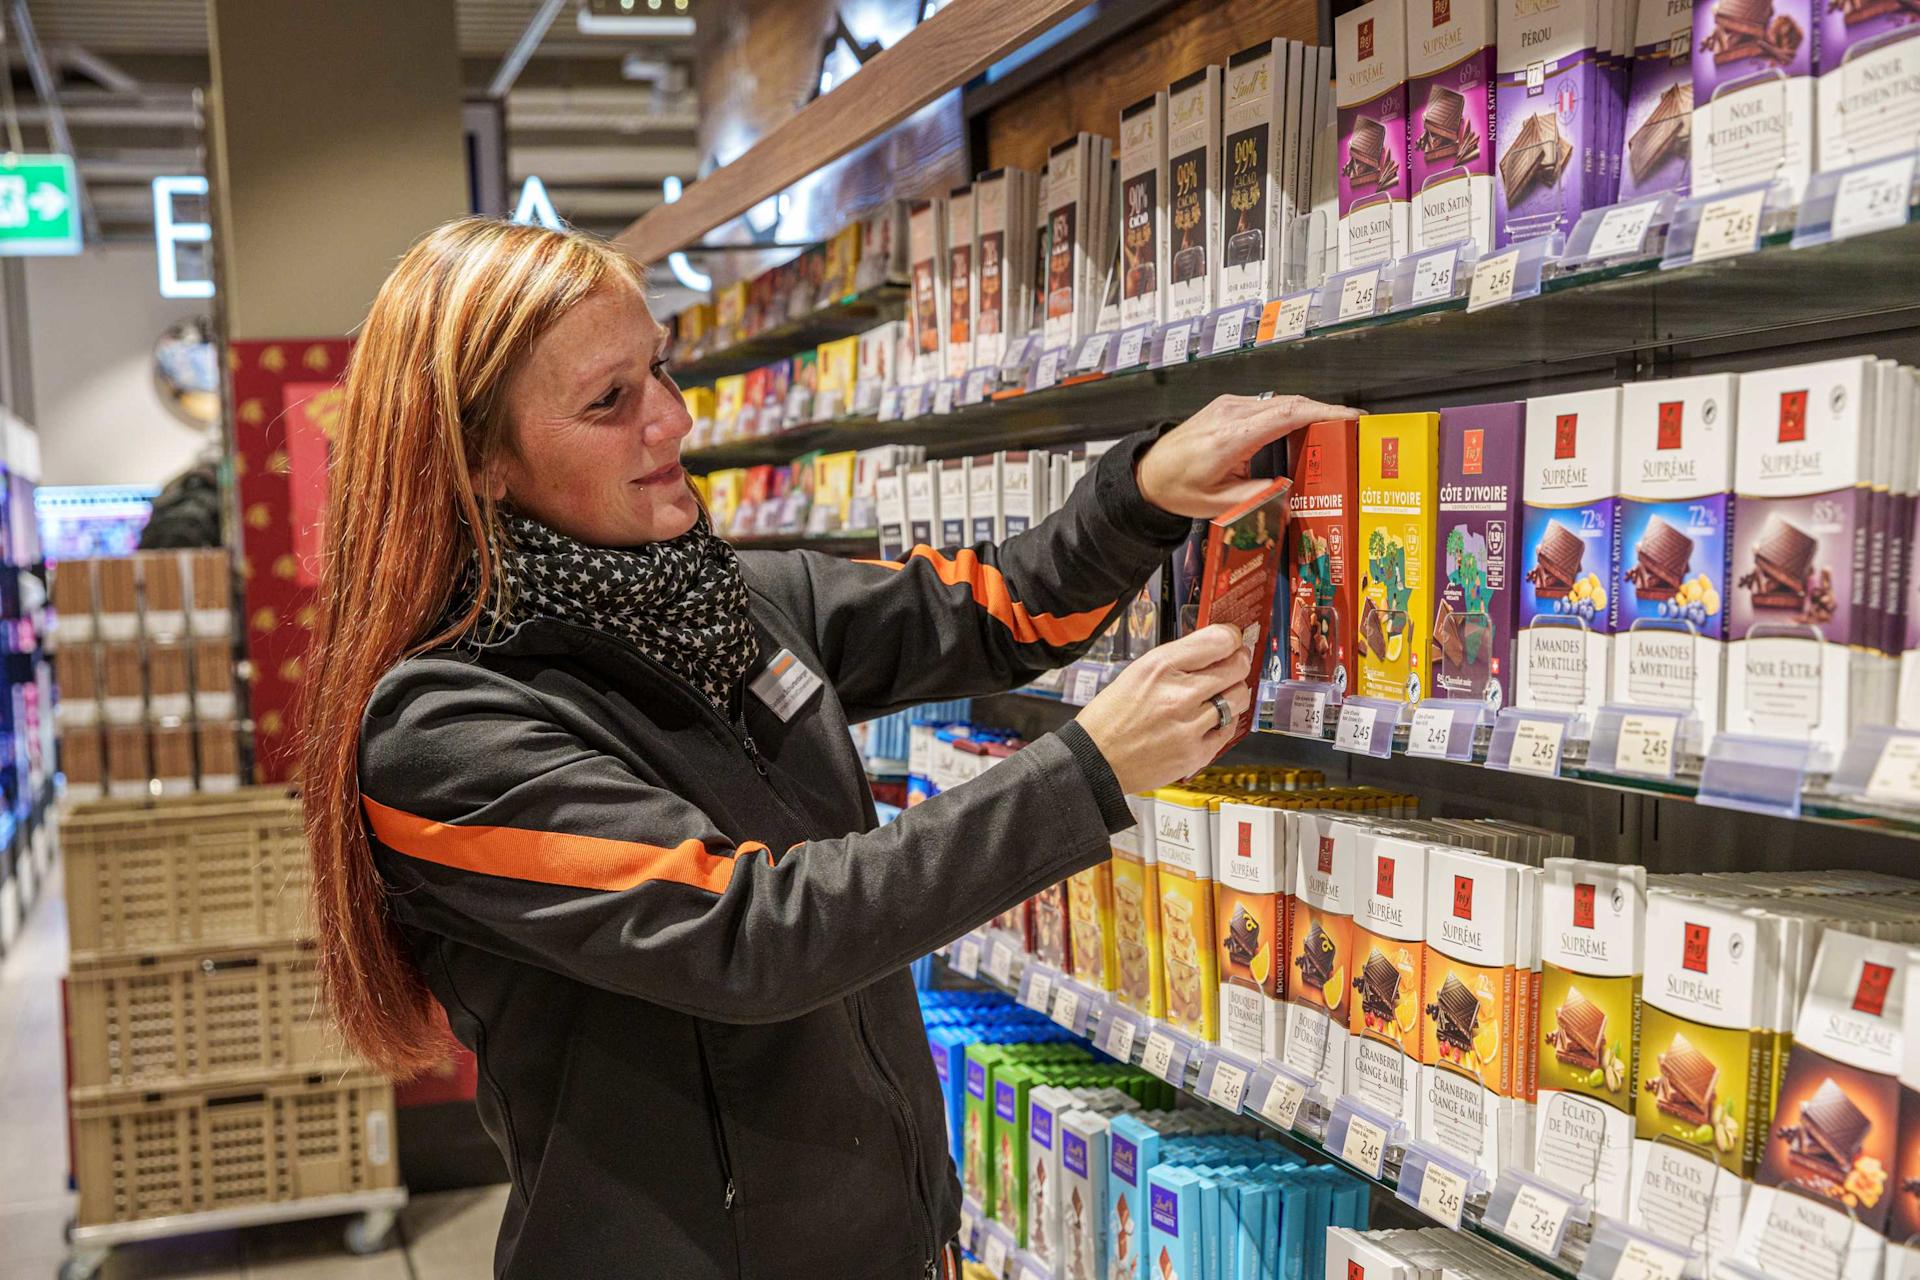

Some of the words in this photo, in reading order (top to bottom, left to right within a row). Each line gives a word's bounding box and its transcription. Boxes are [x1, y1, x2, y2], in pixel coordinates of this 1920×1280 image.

[1423, 28, 1463, 56] SUPRÊME
[1521, 26, 1552, 48] PÉROU
[1349, 63, 1384, 87] SUPRÊME
[1459, 63, 1480, 83] 69%
[1487, 80, 1495, 112] SATIN
[1730, 99, 1764, 120] NOIR
[1488, 114, 1496, 141] NOIR
[1234, 137, 1257, 175] 99%
[1177, 160, 1198, 197] 99%
[1129, 181, 1148, 217] 90%
[1424, 203, 1446, 219] NOIR
[1448, 195, 1472, 212] SATIN
[1349, 225, 1367, 240] NOIR
[1370, 220, 1391, 234] SATIN
[1616, 220, 1643, 239] 2.45
[1723, 216, 1753, 238] 2.45
[1431, 270, 1450, 287] 2.45
[1490, 271, 1511, 290] 2.45
[1356, 288, 1373, 304] 2.45
[1289, 311, 1305, 326] 2.45
[1643, 456, 1696, 479] SUPRÊME
[1761, 450, 1822, 474] SUPRÊME
[1542, 464, 1587, 486] SUPRÊME
[1290, 493, 1307, 510] CÔTE
[1310, 494, 1342, 508] D'IVOIRE
[1361, 486, 1381, 505] CÔTE
[1384, 491, 1421, 506] D'IVOIRE
[1440, 482, 1463, 502] CÔTE
[1465, 486, 1508, 501] D'IVOIRE
[1581, 510, 1605, 529] 72%
[1688, 505, 1718, 526] 72%
[1535, 637, 1580, 653] AMANDES
[1637, 641, 1690, 661] AMANDES
[1529, 657, 1535, 668] &
[1538, 656, 1588, 672] MYRTILLES
[1630, 661, 1637, 675] &
[1640, 662, 1698, 681] MYRTILLES
[1746, 661, 1776, 678] NOIR
[1781, 660, 1822, 678] EXTRA
[1305, 709, 1320, 724] 2.45
[1353, 724, 1370, 740] 2.45
[1428, 728, 1447, 744] 2.45
[1532, 742, 1555, 759] 2.45
[1642, 738, 1667, 758] 2.45
[1161, 814, 1183, 840] Lindt
[1231, 860, 1259, 879] SUPRÊME
[1308, 875, 1339, 898] SUPRÊME
[1367, 898, 1403, 924] SUPRÊME
[1442, 921, 1482, 947] SUPRÊME
[1561, 932, 1608, 957] SUPRÊME
[1667, 974, 1723, 1006] SUPRÊME
[1231, 991, 1258, 1011] BOUQUET
[1633, 993, 1642, 1041] PISTACHE
[1828, 1014, 1894, 1051] SUPRÊME
[1155, 1052, 1169, 1066] 4.25
[1633, 1045, 1640, 1060] DE
[1224, 1081, 1239, 1098] 2.45
[1390, 1073, 1408, 1091] MIEL
[1279, 1097, 1296, 1115] 2.45
[1460, 1106, 1466, 1118] &
[1468, 1108, 1488, 1127] MIEL
[1549, 1117, 1561, 1132] DE
[1361, 1140, 1379, 1161] 2.45
[1647, 1170, 1657, 1187] DE
[1439, 1189, 1459, 1211] 2.45
[1530, 1214, 1556, 1237] 2.45
